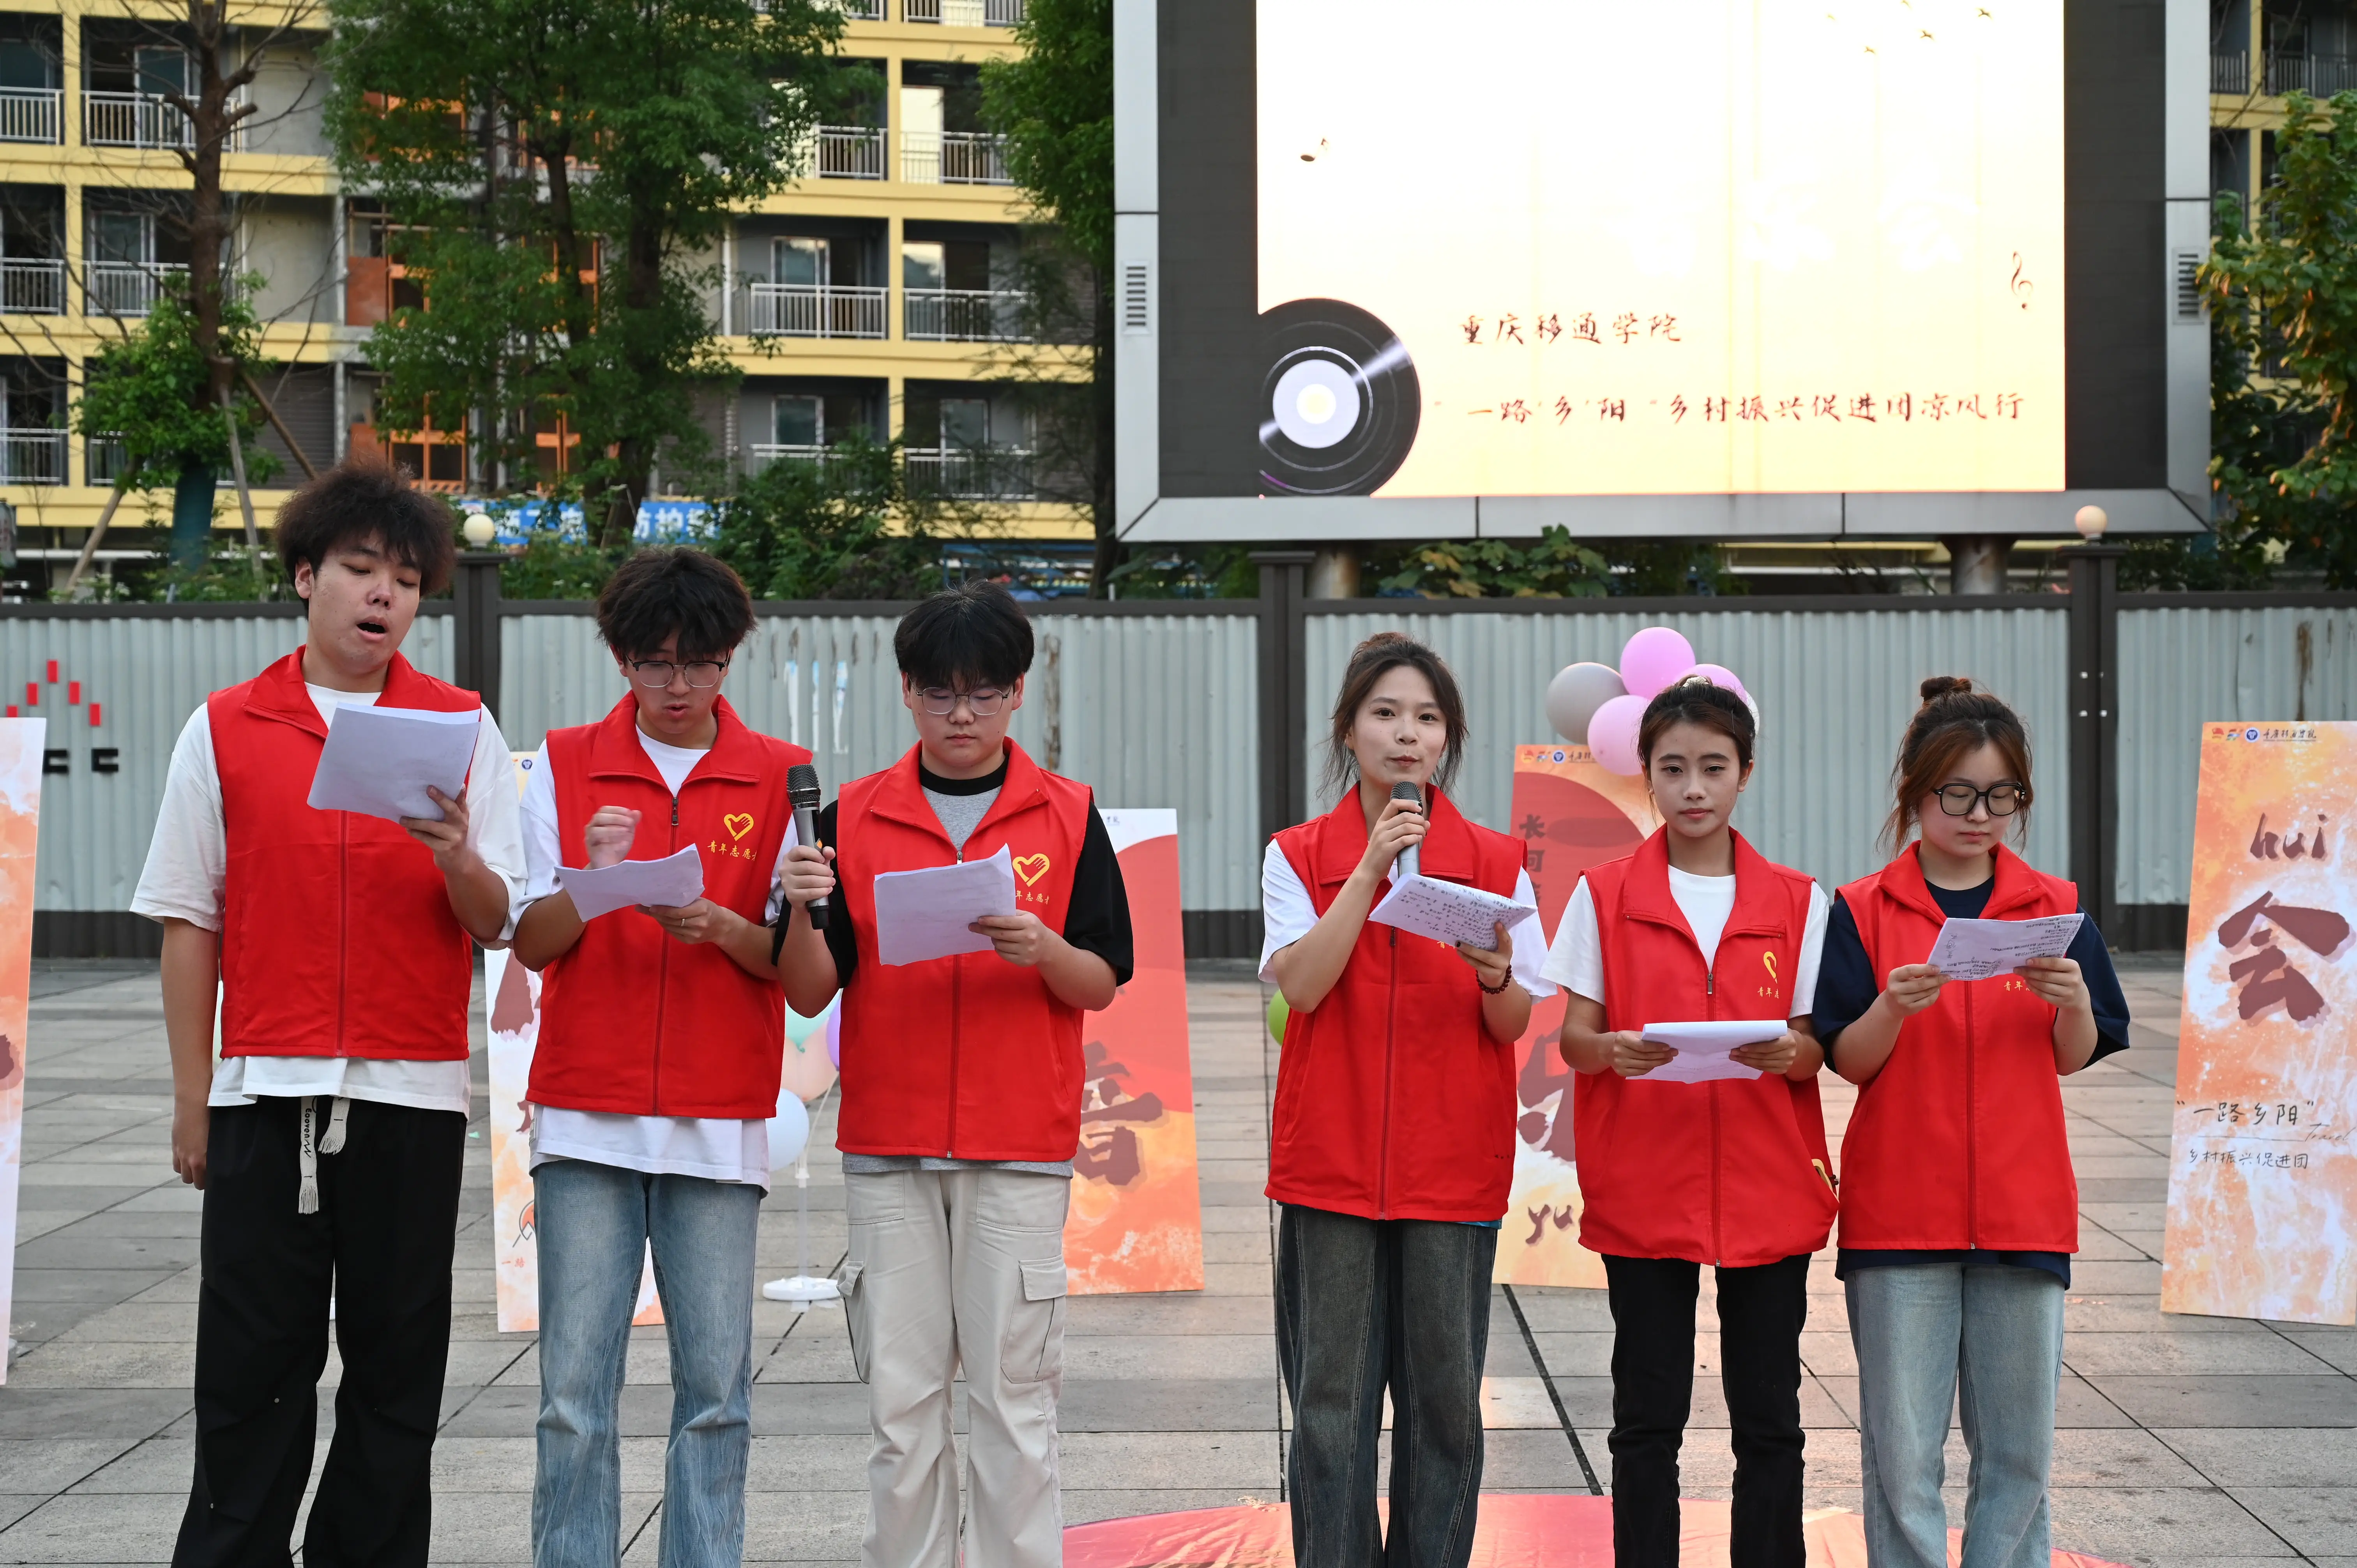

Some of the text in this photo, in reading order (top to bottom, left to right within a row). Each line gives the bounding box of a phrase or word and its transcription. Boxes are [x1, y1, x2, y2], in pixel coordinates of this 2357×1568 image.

[1459, 312, 1681, 344] 重庆移通学院
[2217, 890, 2350, 1022] 会
[2003, 980, 2030, 991] 青年
[2189, 1148, 2308, 1169] 乡村振兴促进团
